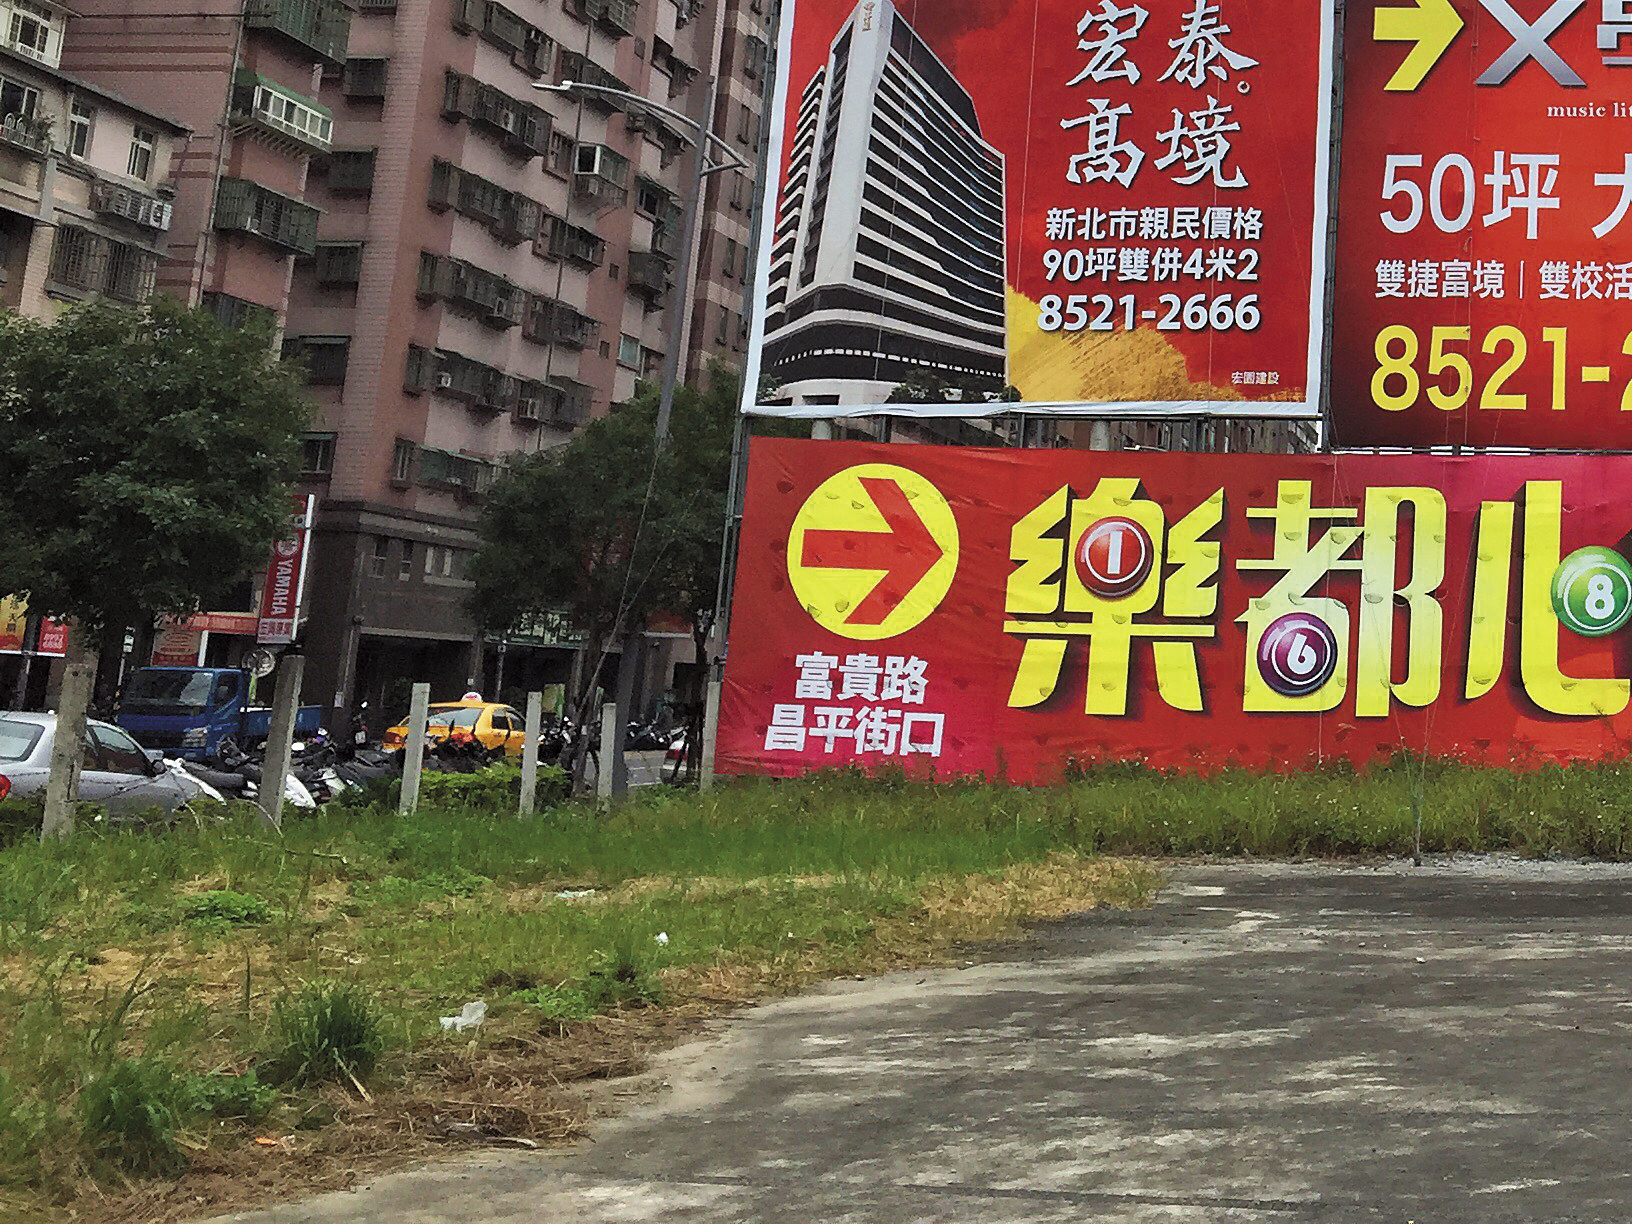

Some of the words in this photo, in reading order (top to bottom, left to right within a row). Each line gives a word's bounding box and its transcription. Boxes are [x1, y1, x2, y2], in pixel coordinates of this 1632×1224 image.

[1547, 102, 1606, 117] music
[1379, 150, 1560, 240] 50坪
[1045, 206, 1264, 241] 新北市親民價格
[1042, 246, 1259, 282] 90坪雙併4米2
[1375, 258, 1505, 299] 雙捷富境
[1037, 293, 1260, 331] 8521-2666
[270, 558, 294, 616] YAMAHA
[794, 650, 930, 704] 富貴路
[764, 703, 946, 757] 昌平街口
